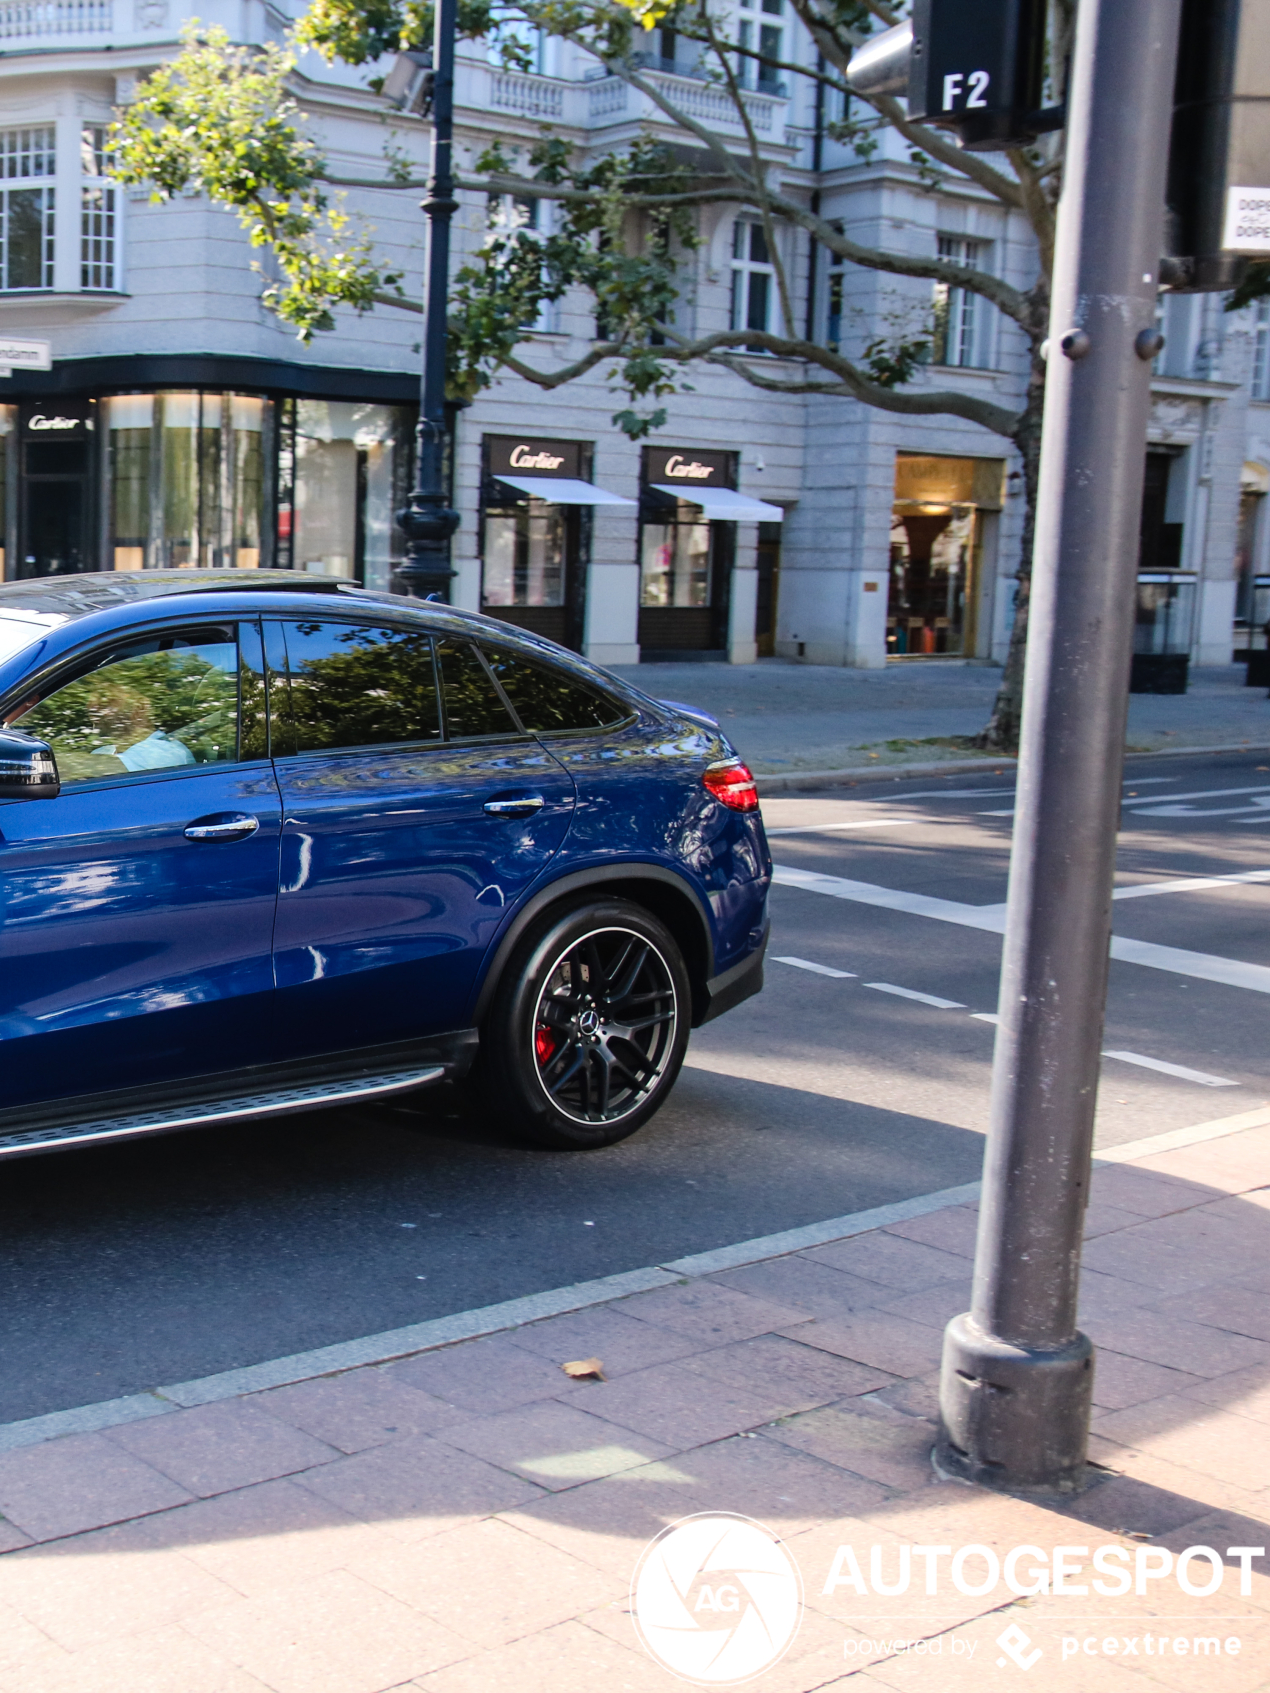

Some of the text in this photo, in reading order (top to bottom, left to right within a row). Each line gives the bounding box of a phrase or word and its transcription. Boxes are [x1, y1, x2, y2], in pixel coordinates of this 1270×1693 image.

[942, 71, 990, 111] F2
[28, 415, 80, 430] Cartier
[509, 444, 565, 470] Cartier
[664, 455, 715, 479] Cartier
